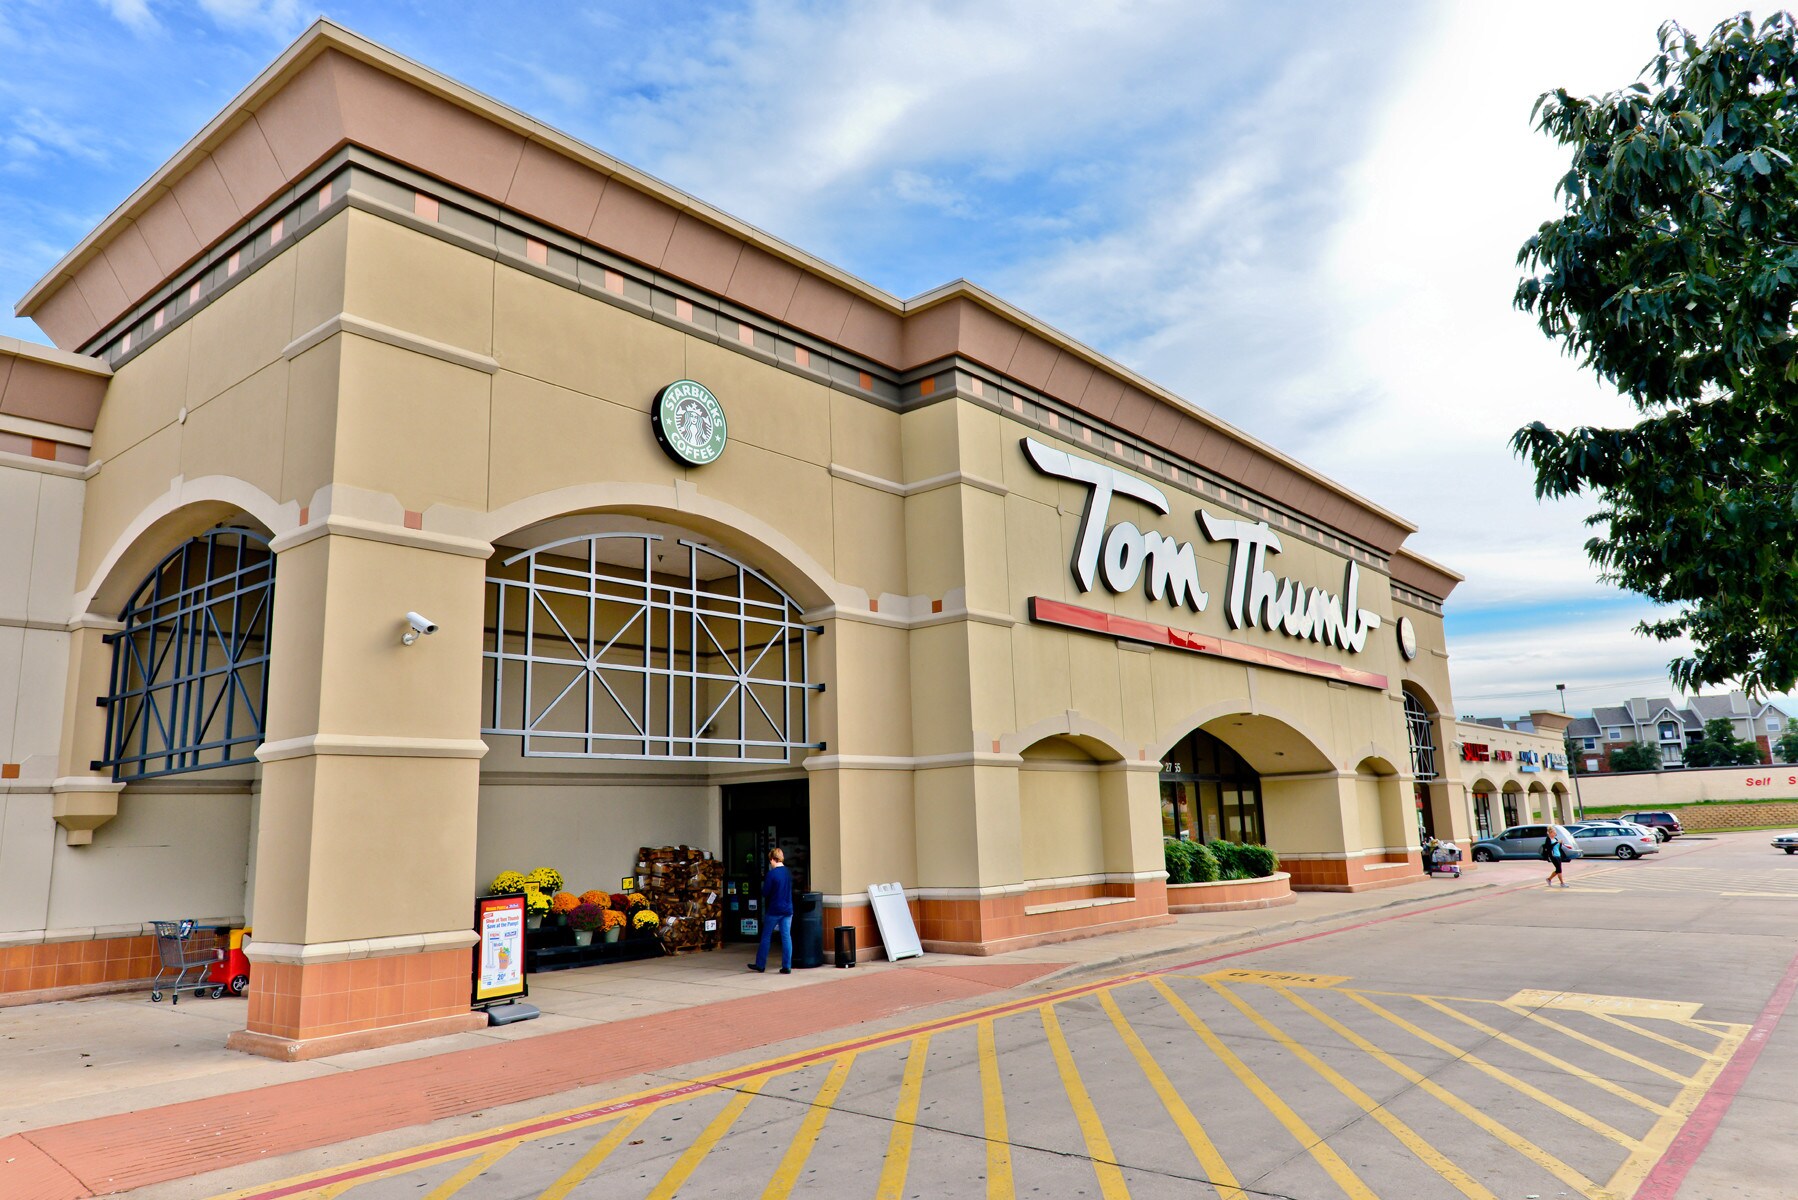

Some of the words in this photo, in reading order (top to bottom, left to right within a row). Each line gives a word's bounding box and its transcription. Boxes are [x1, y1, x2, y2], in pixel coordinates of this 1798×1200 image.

[665, 385, 723, 428] STARBUCKS
[671, 432, 715, 460] COFFEE
[1020, 436, 1209, 613] Tom
[1195, 508, 1382, 653] Thumb
[1745, 777, 1771, 787] Self
[1228, 971, 1318, 983] YIELD
